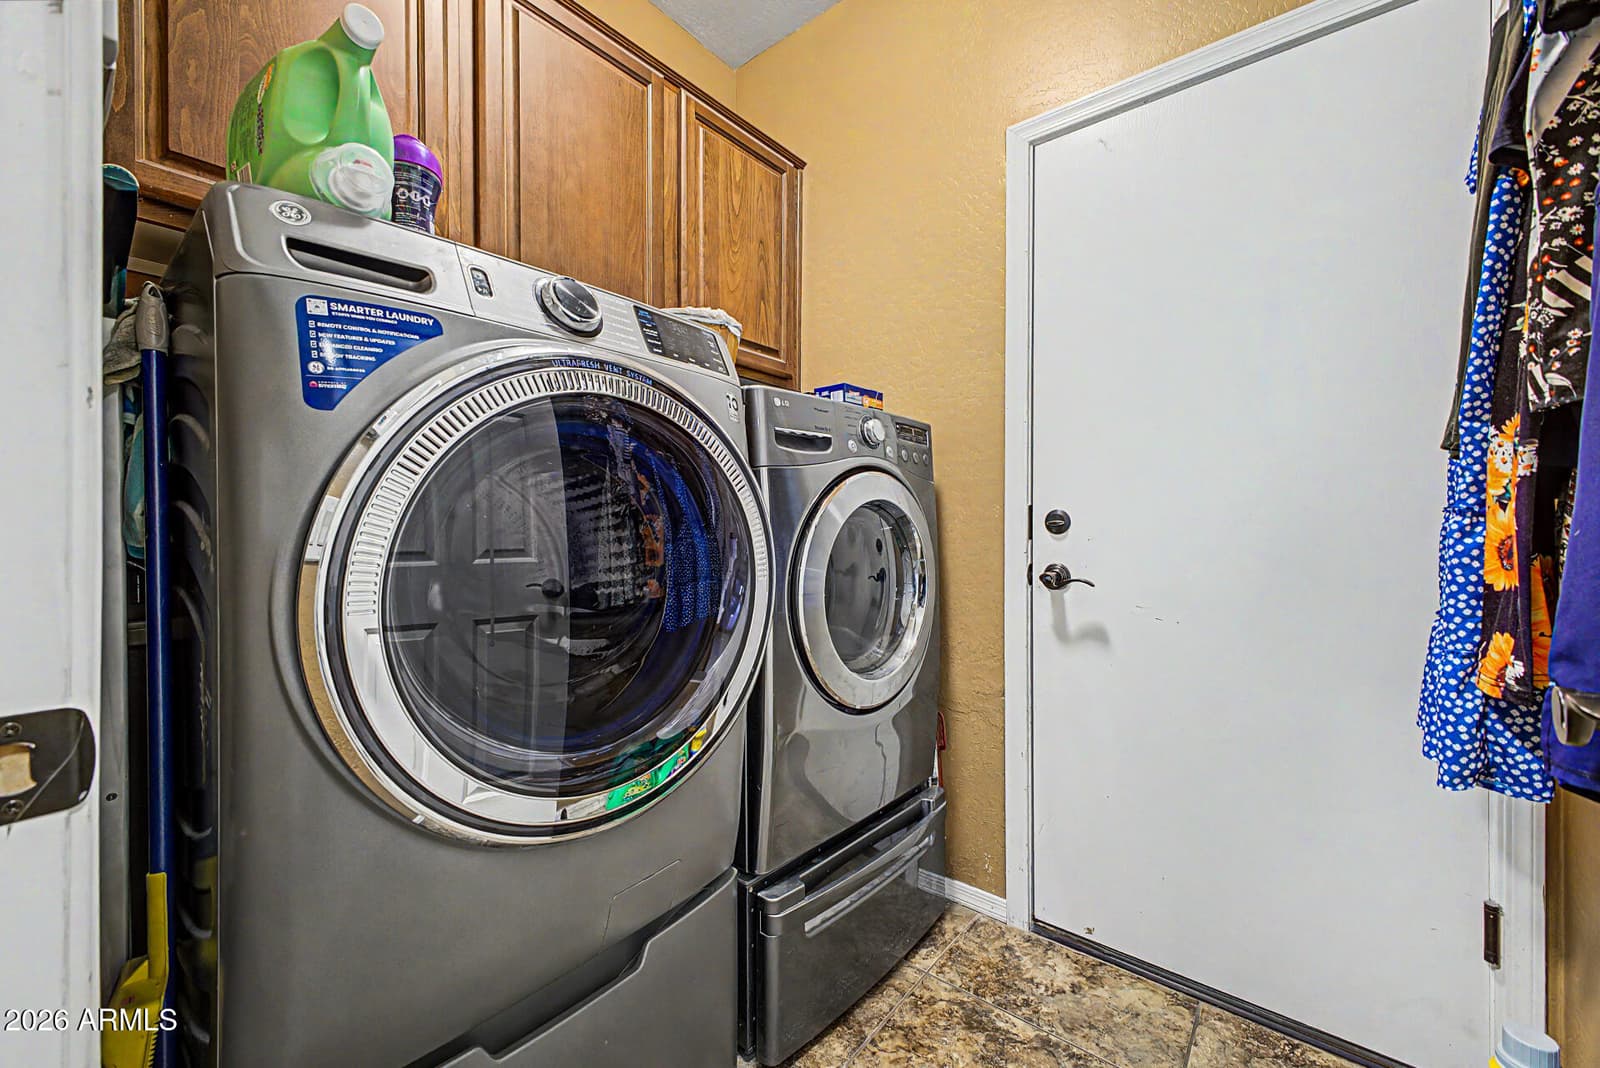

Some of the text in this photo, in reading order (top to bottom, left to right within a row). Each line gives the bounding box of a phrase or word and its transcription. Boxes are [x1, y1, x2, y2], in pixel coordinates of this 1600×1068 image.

[330, 302, 434, 326] SMARTER LAUNDRY
[317, 321, 342, 329] REMOTE
[343, 324, 371, 333] CONTROL
[377, 329, 420, 340] NOTIFICATIONS
[333, 333, 363, 342] FEATURES
[369, 337, 396, 346] UPDATES
[353, 345, 384, 353] CLEANING
[552, 359, 653, 386] ULTRAFRESH VENT SYSTEM
